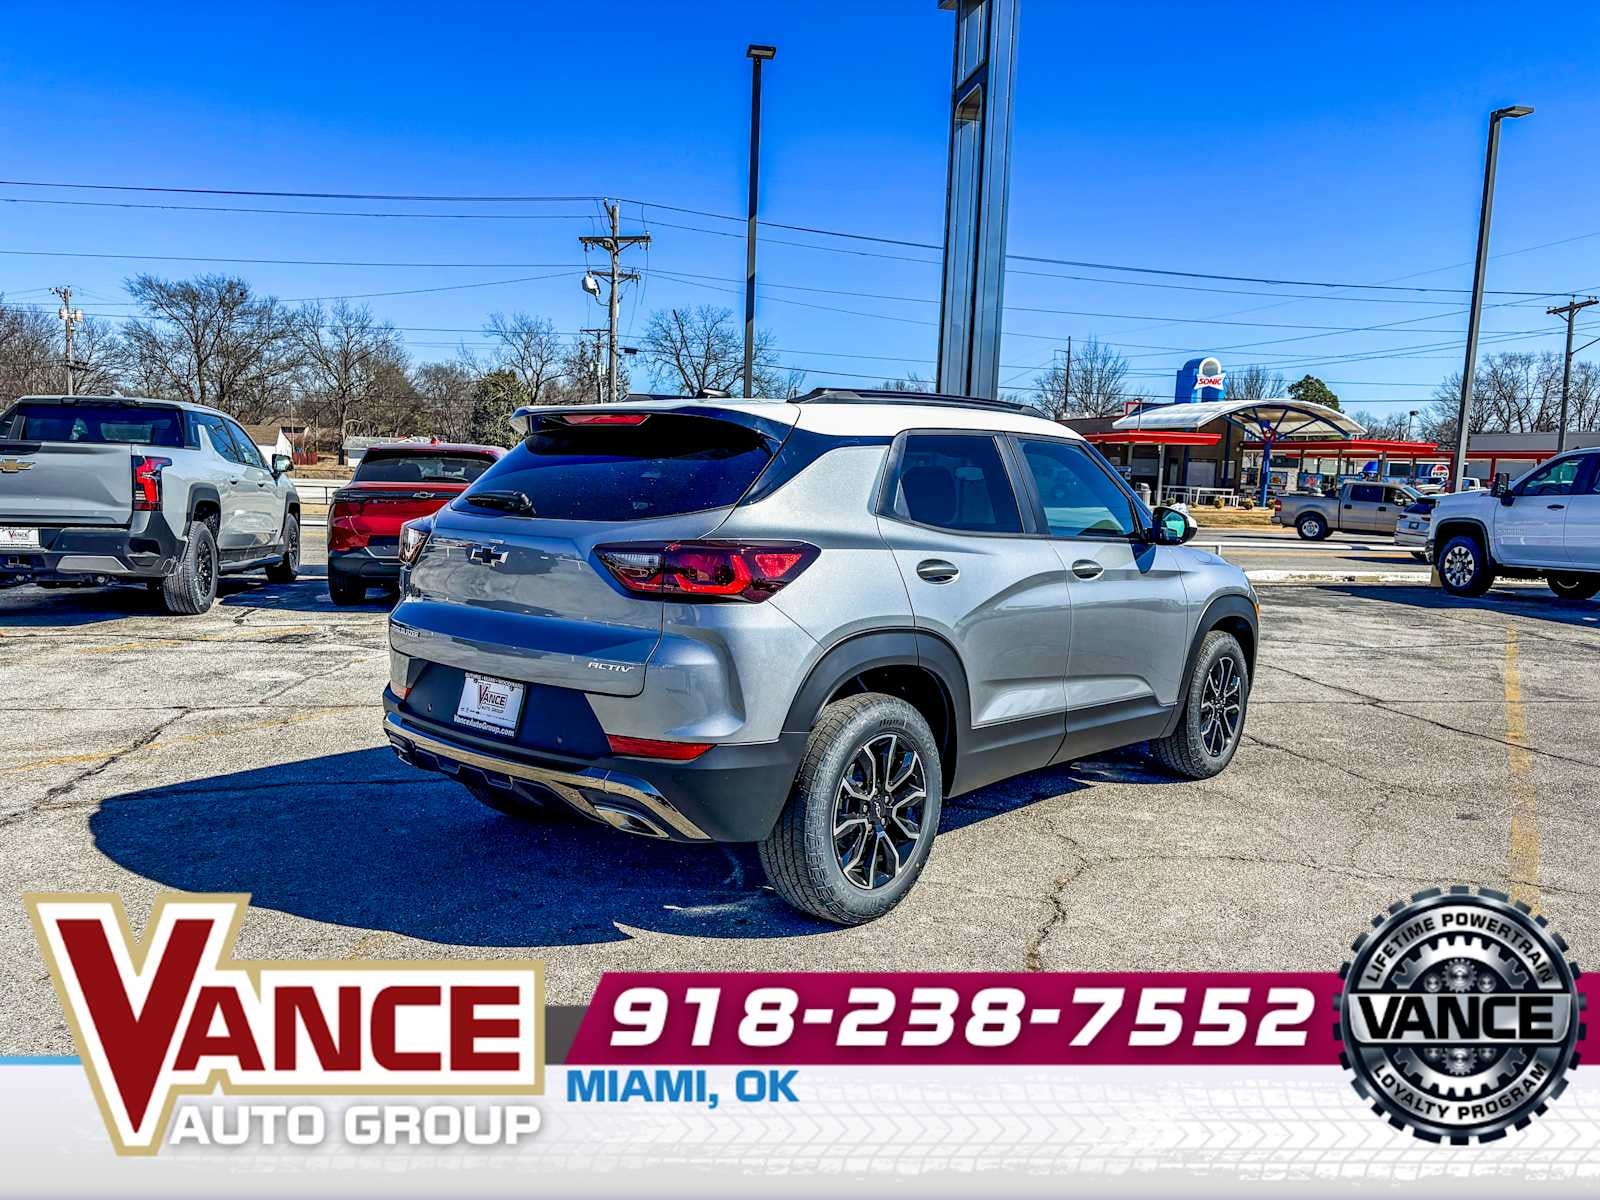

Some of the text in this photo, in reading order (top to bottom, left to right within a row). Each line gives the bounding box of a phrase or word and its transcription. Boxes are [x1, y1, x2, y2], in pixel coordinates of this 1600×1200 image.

[587, 661, 635, 673] ACTIV
[479, 684, 505, 708] VANCE
[453, 714, 514, 736] VanceAutoGroup.com
